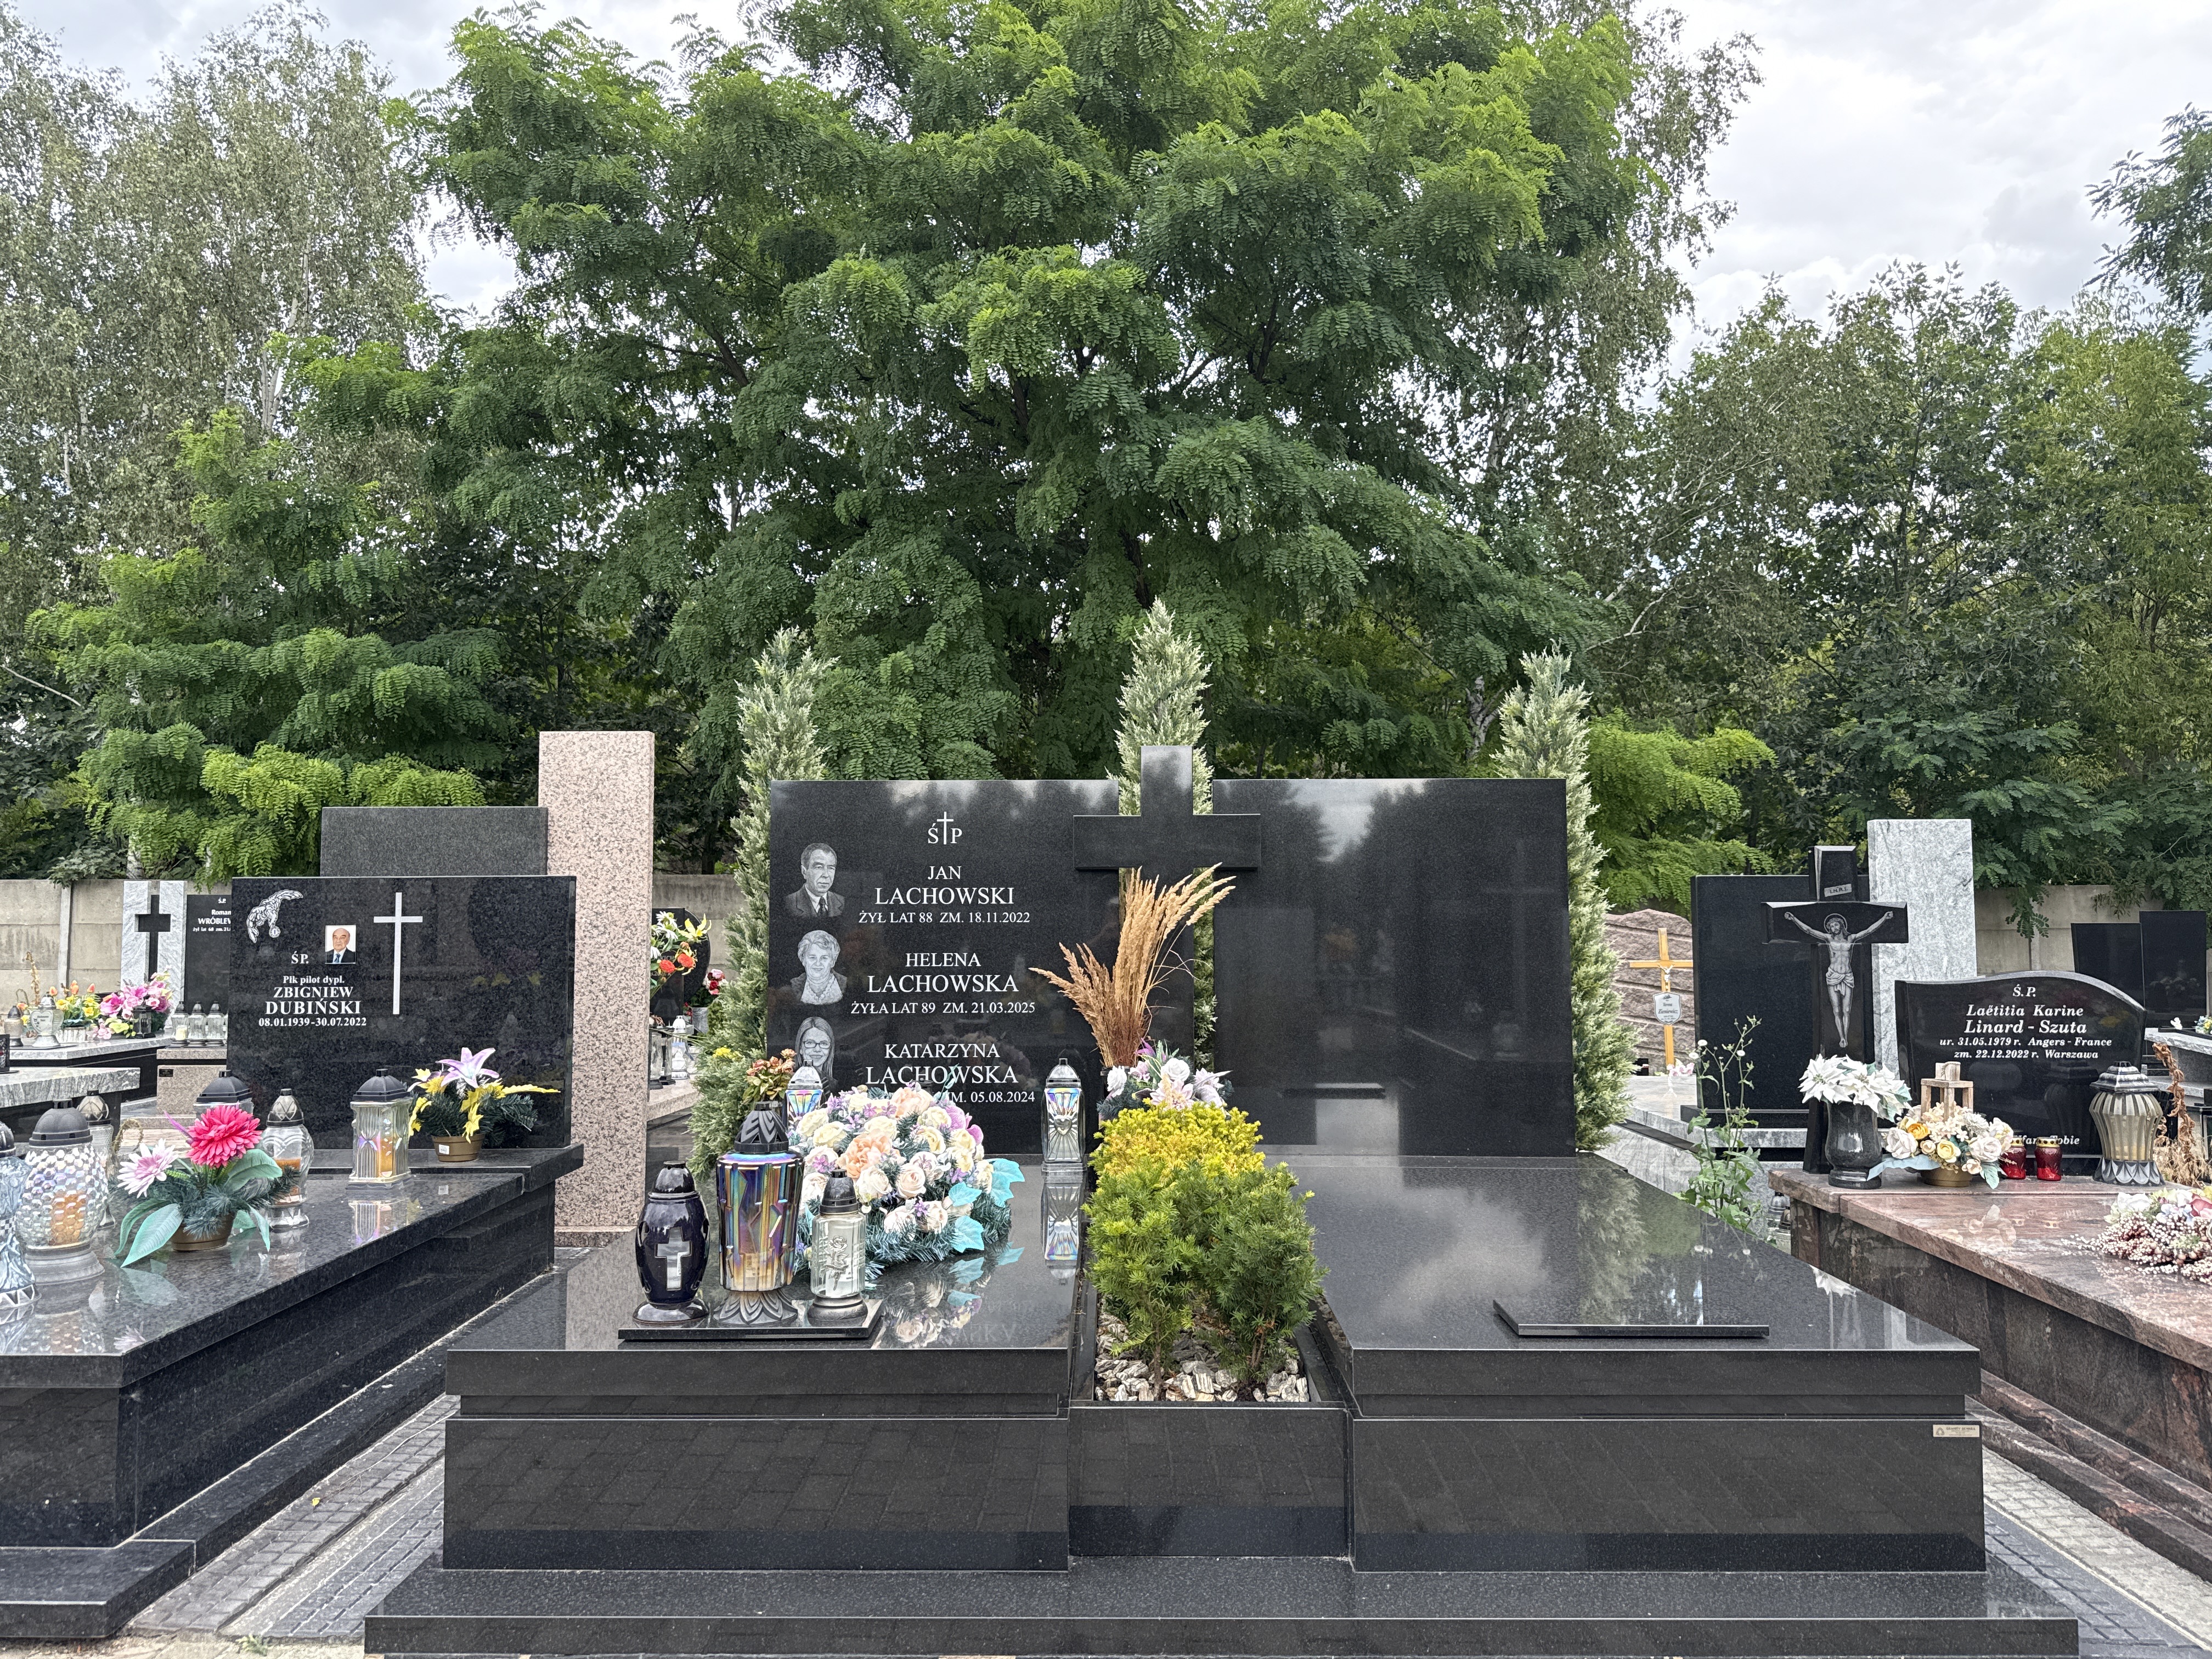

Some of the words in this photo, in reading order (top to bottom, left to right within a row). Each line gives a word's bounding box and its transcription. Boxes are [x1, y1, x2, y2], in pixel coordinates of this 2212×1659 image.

[950, 828, 962, 843] P
[928, 866, 962, 879] JAN
[874, 888, 1014, 904] LACHOWSKI
[859, 910, 886, 923] ŻYŁ
[890, 912, 916, 922] LAT
[919, 912, 932, 923] 88
[940, 912, 964, 923] ZM.
[969, 912, 1030, 922] 18.11.2022
[905, 953, 981, 967] HELENA
[300, 975, 320, 985] pilot
[323, 975, 345, 985] dypl.
[867, 975, 1019, 992] LACHOWSKA
[273, 986, 353, 998] ZBIGNIEW
[265, 998, 361, 1014] DUBIŃSKI
[851, 1001, 889, 1013] ŻYŁA
[892, 1003, 918, 1013] LAT
[922, 1002, 935, 1013] 89
[943, 1003, 967, 1013] ZM.
[972, 1002, 1035, 1013] 21.03.2025
[1966, 1005, 2024, 1016] Laëtitia
[2033, 1005, 2083, 1016] Karine
[1964, 1020, 2023, 1033] Linard
[2039, 1020, 2086, 1033] Szuta
[2028, 1037, 2065, 1047] Angers
[2074, 1037, 2112, 1046] France
[884, 1043, 1000, 1058] KATARZYNA
[2045, 1049, 2098, 1058] Warszawa
[866, 1066, 1019, 1084] LACHOWSKA
[950, 1091, 967, 1103] M.
[971, 1092, 1035, 1102] 05.08.2024
